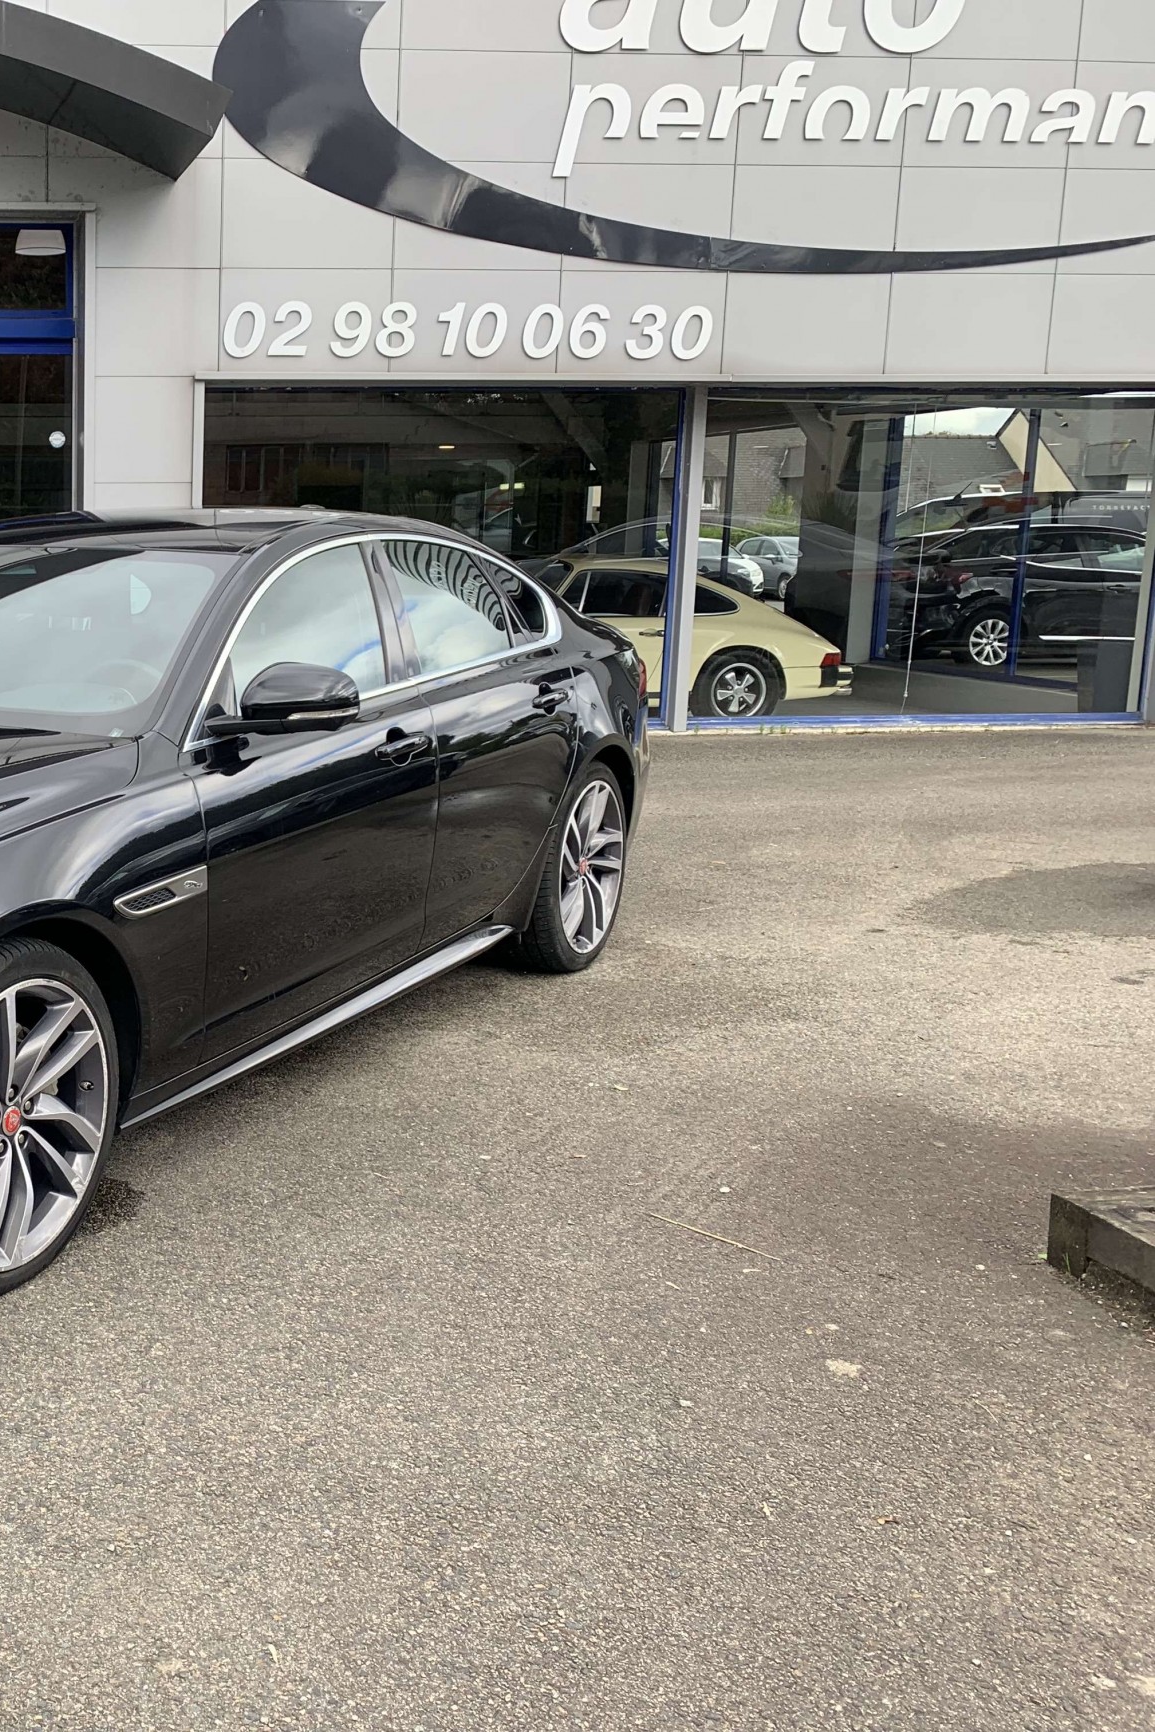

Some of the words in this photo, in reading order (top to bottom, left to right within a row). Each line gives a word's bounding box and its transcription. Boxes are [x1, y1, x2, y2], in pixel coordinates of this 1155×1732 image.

[222, 300, 314, 359] 02
[330, 301, 418, 359] 98
[437, 302, 508, 358] 10
[522, 303, 611, 360] 06
[625, 304, 713, 361] 30
